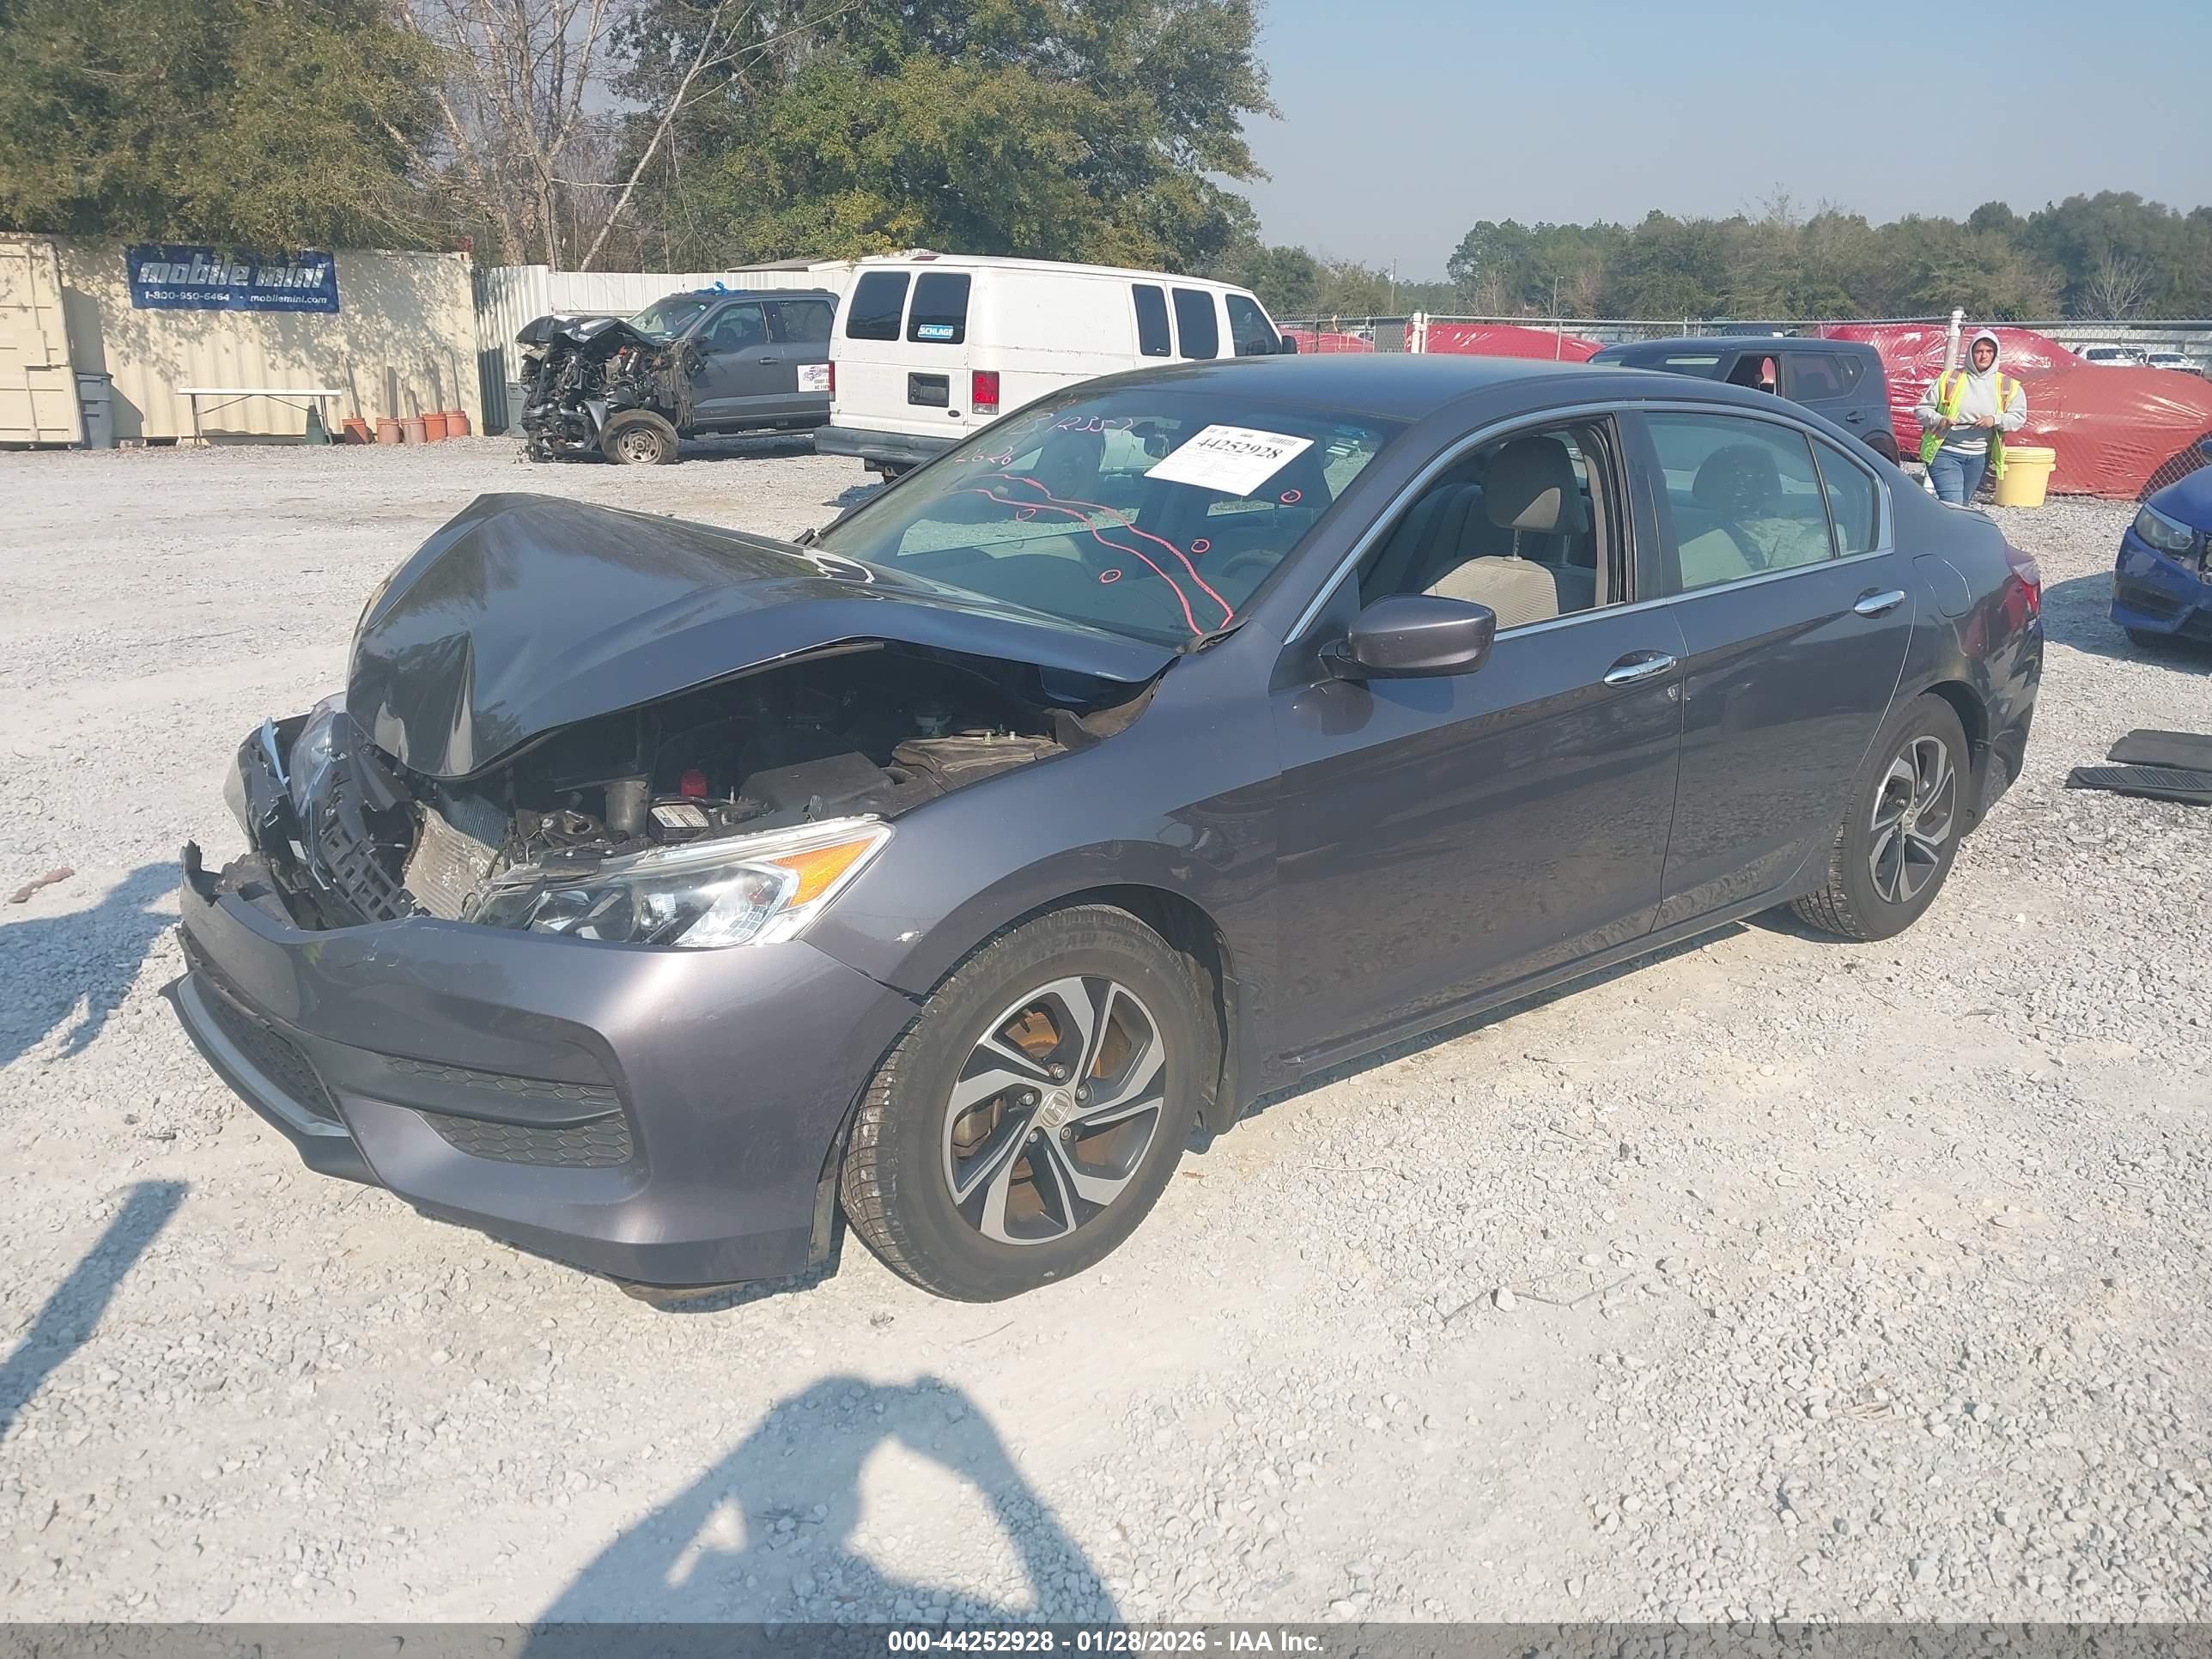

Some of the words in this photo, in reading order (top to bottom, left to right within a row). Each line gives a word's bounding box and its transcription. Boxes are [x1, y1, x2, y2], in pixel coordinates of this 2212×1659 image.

[137, 253, 251, 286] mobile
[255, 261, 331, 289] mini
[144, 290, 230, 301] 1-800-950-6464
[250, 293, 327, 304] mobilemini.com
[918, 326, 954, 336] SCHLAGE
[1196, 437, 1285, 460] 44252928
